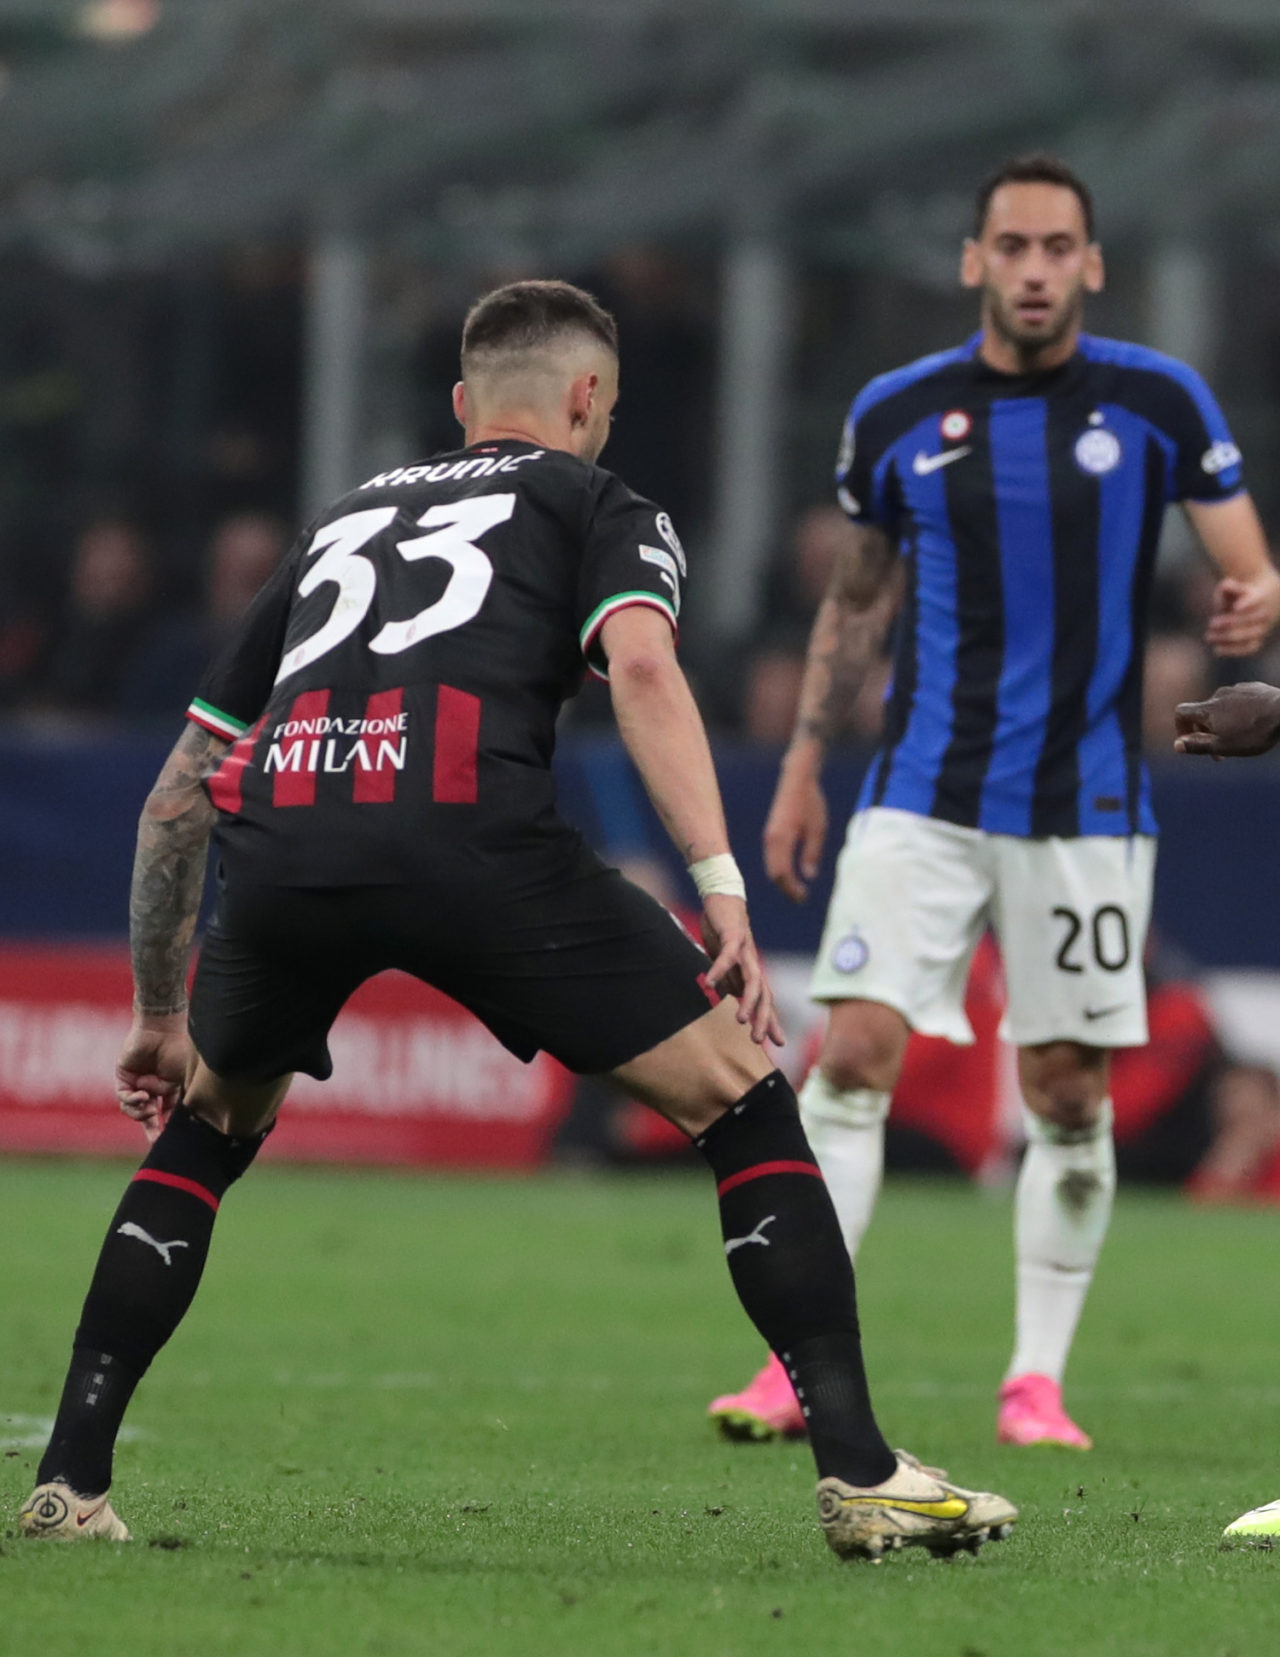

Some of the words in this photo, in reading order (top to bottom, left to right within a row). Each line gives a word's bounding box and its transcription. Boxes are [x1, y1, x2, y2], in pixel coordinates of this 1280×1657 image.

[275, 493, 516, 686] 33
[273, 712, 409, 739] FONDAZIONE
[263, 736, 408, 774] MILAN
[1052, 905, 1130, 972] 20
